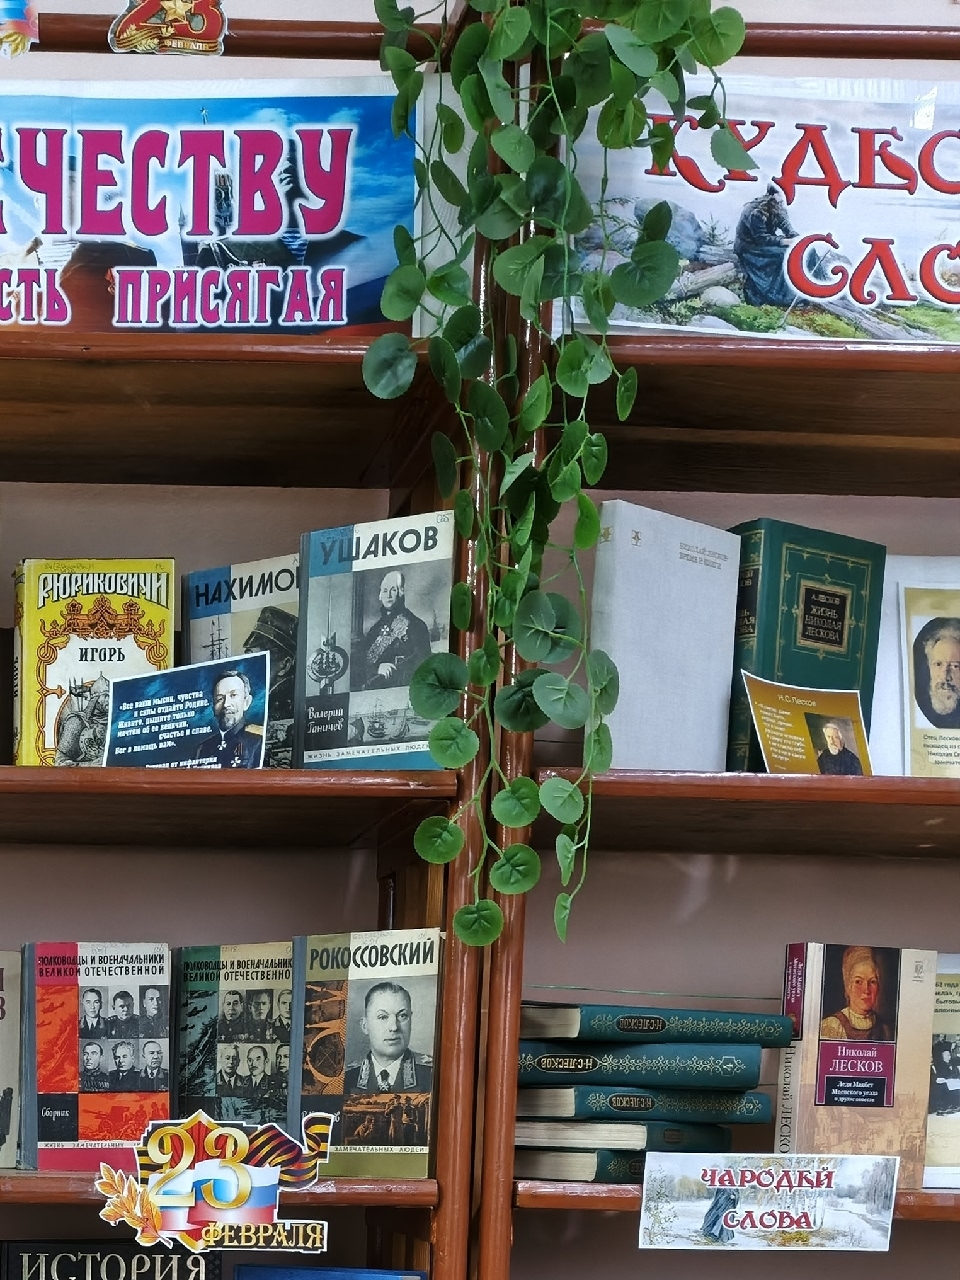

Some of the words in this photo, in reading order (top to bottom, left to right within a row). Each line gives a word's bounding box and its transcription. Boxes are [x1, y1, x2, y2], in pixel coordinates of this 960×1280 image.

[113, 266, 346, 325] ПРИСЯГАЯ
[320, 525, 439, 566] УШАКОВ
[37, 572, 170, 610] РЮРИКОВИЧИ
[805, 614, 842, 631] НИКОЛАЯ
[805, 626, 840, 642] ЛЕСКОВА
[78, 645, 125, 663] ИГОРЬ
[309, 937, 435, 971] РОКОССОВСКИЙ
[837, 1046, 877, 1058] Николай
[829, 1059, 883, 1073] ЛЕСКОВ
[146, 1125, 252, 1211] 23
[701, 1165, 837, 1190] ЧАРОДЕЙ
[723, 1209, 812, 1231] СЛОВА
[203, 1221, 325, 1250] ФЕВРАЛЯ
